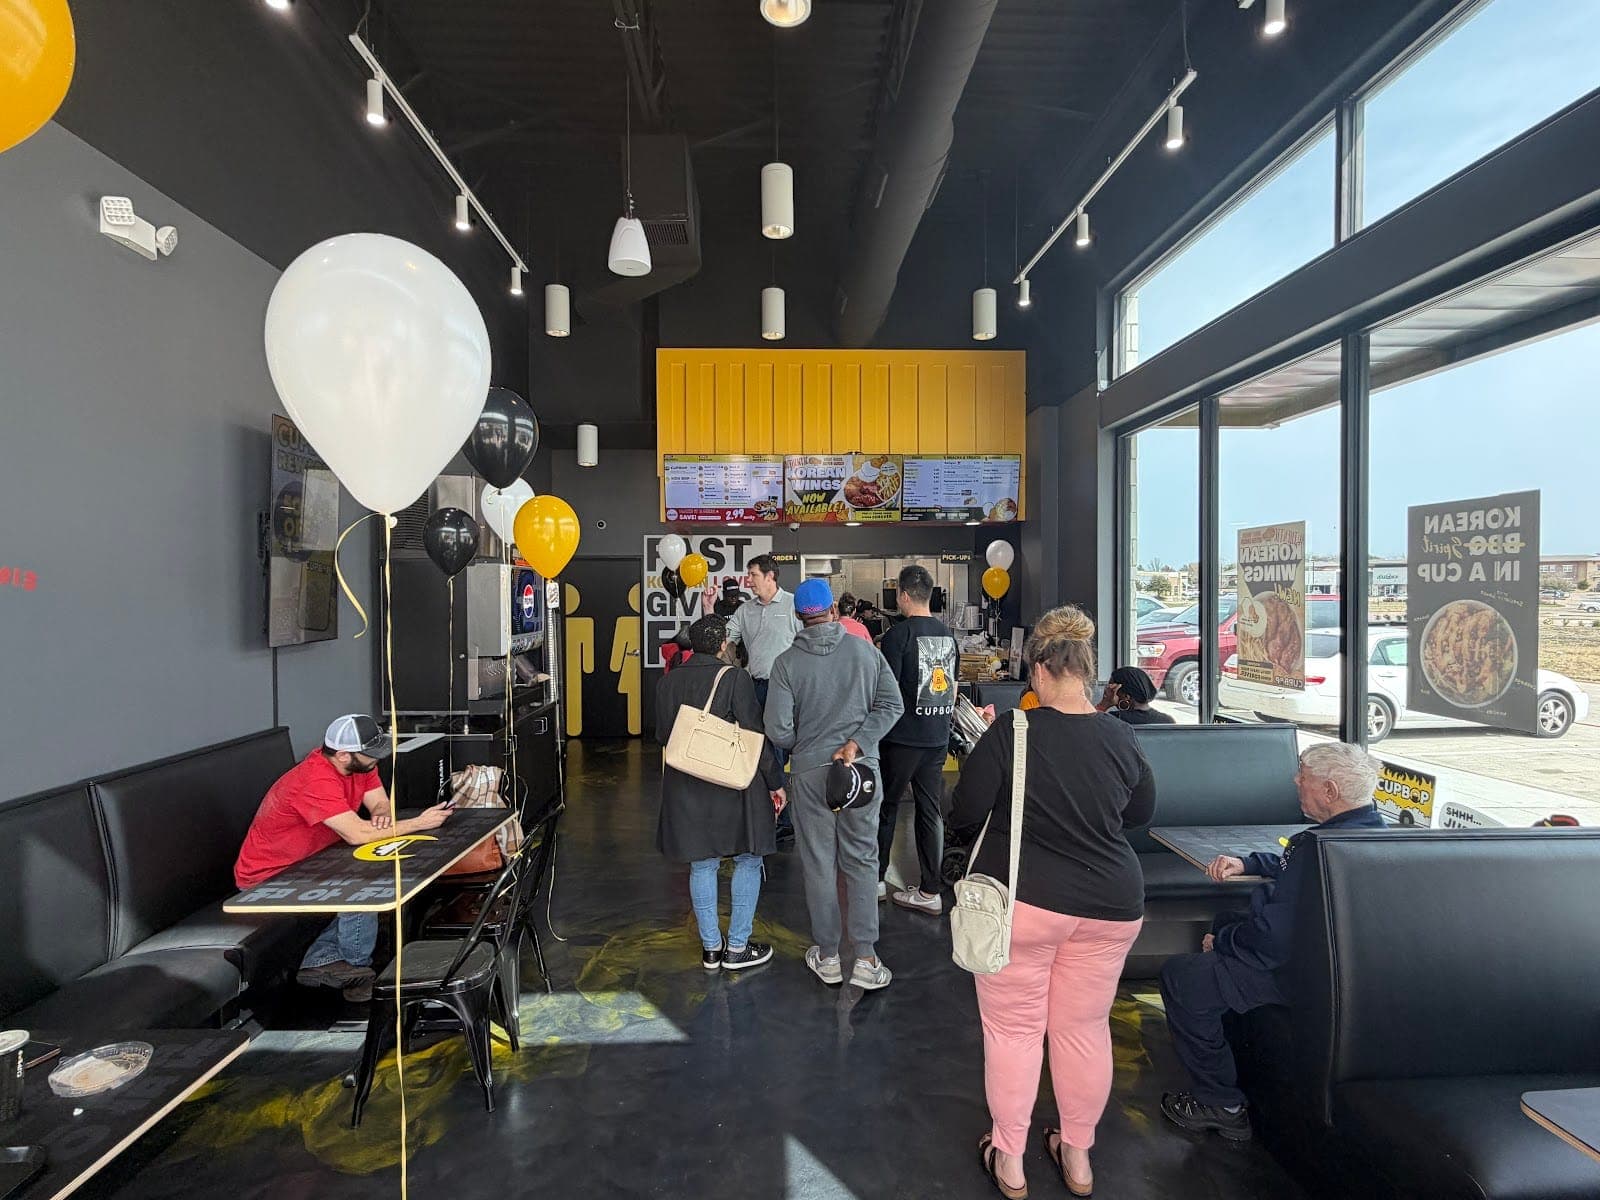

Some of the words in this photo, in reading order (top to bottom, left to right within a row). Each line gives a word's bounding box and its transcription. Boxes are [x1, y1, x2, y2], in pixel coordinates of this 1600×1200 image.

[787, 466, 847, 479] KOREAN
[790, 479, 841, 491] WINGS
[802, 492, 826, 503] NOW
[725, 509, 745, 521] 2.99
[786, 503, 845, 515] AVAILABLE!
[647, 537, 753, 573] FST
[713, 575, 752, 589] LVE
[1375, 776, 1430, 805] CUPBOP
